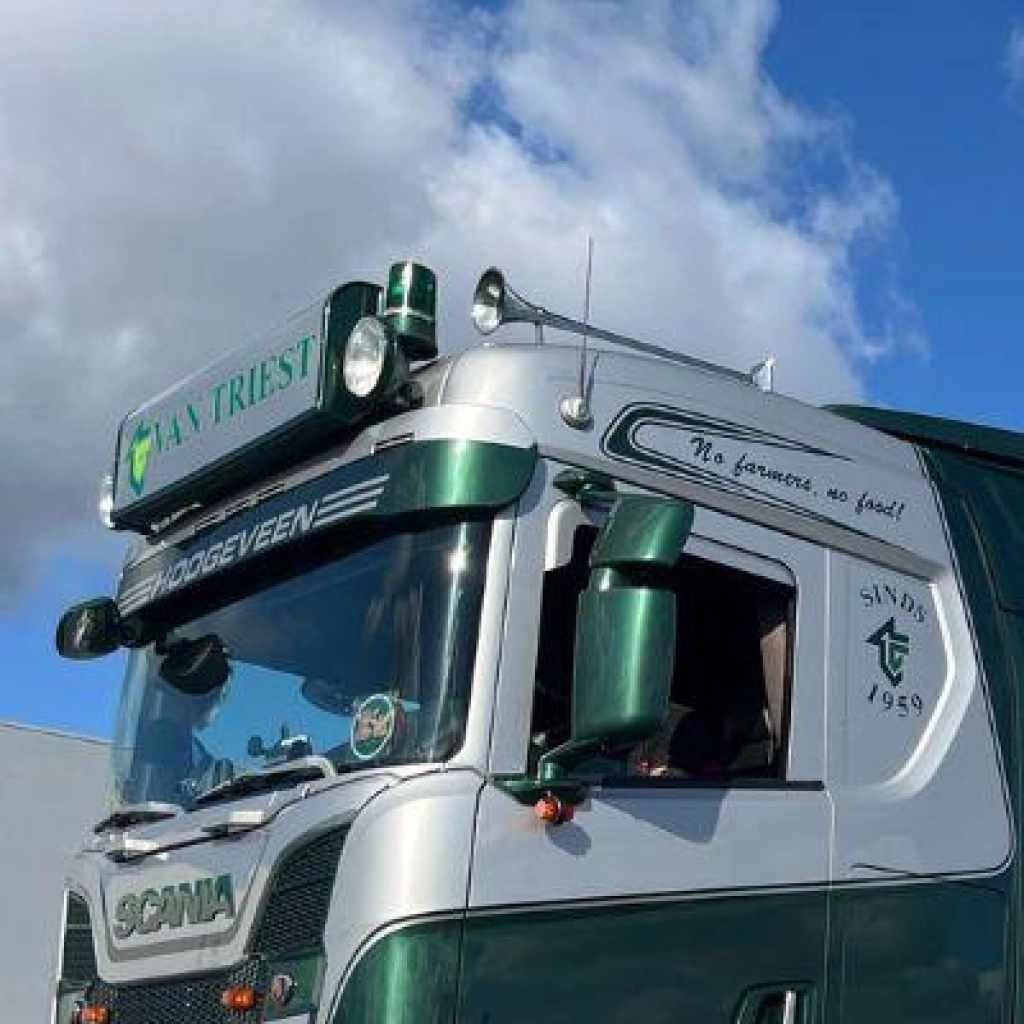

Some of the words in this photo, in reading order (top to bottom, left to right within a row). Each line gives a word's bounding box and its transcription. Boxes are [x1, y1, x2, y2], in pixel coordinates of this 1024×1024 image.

[153, 402, 203, 452] VAN
[210, 333, 316, 424] TRIEST
[690, 437, 724, 464] No
[734, 452, 818, 498] farmers,
[826, 487, 849, 502] no
[855, 491, 905, 522] food!
[150, 498, 320, 598] HOOGEVEEN
[860, 583, 926, 623] SINDS
[867, 683, 923, 718] 1959
[113, 873, 235, 939] SCANIA
